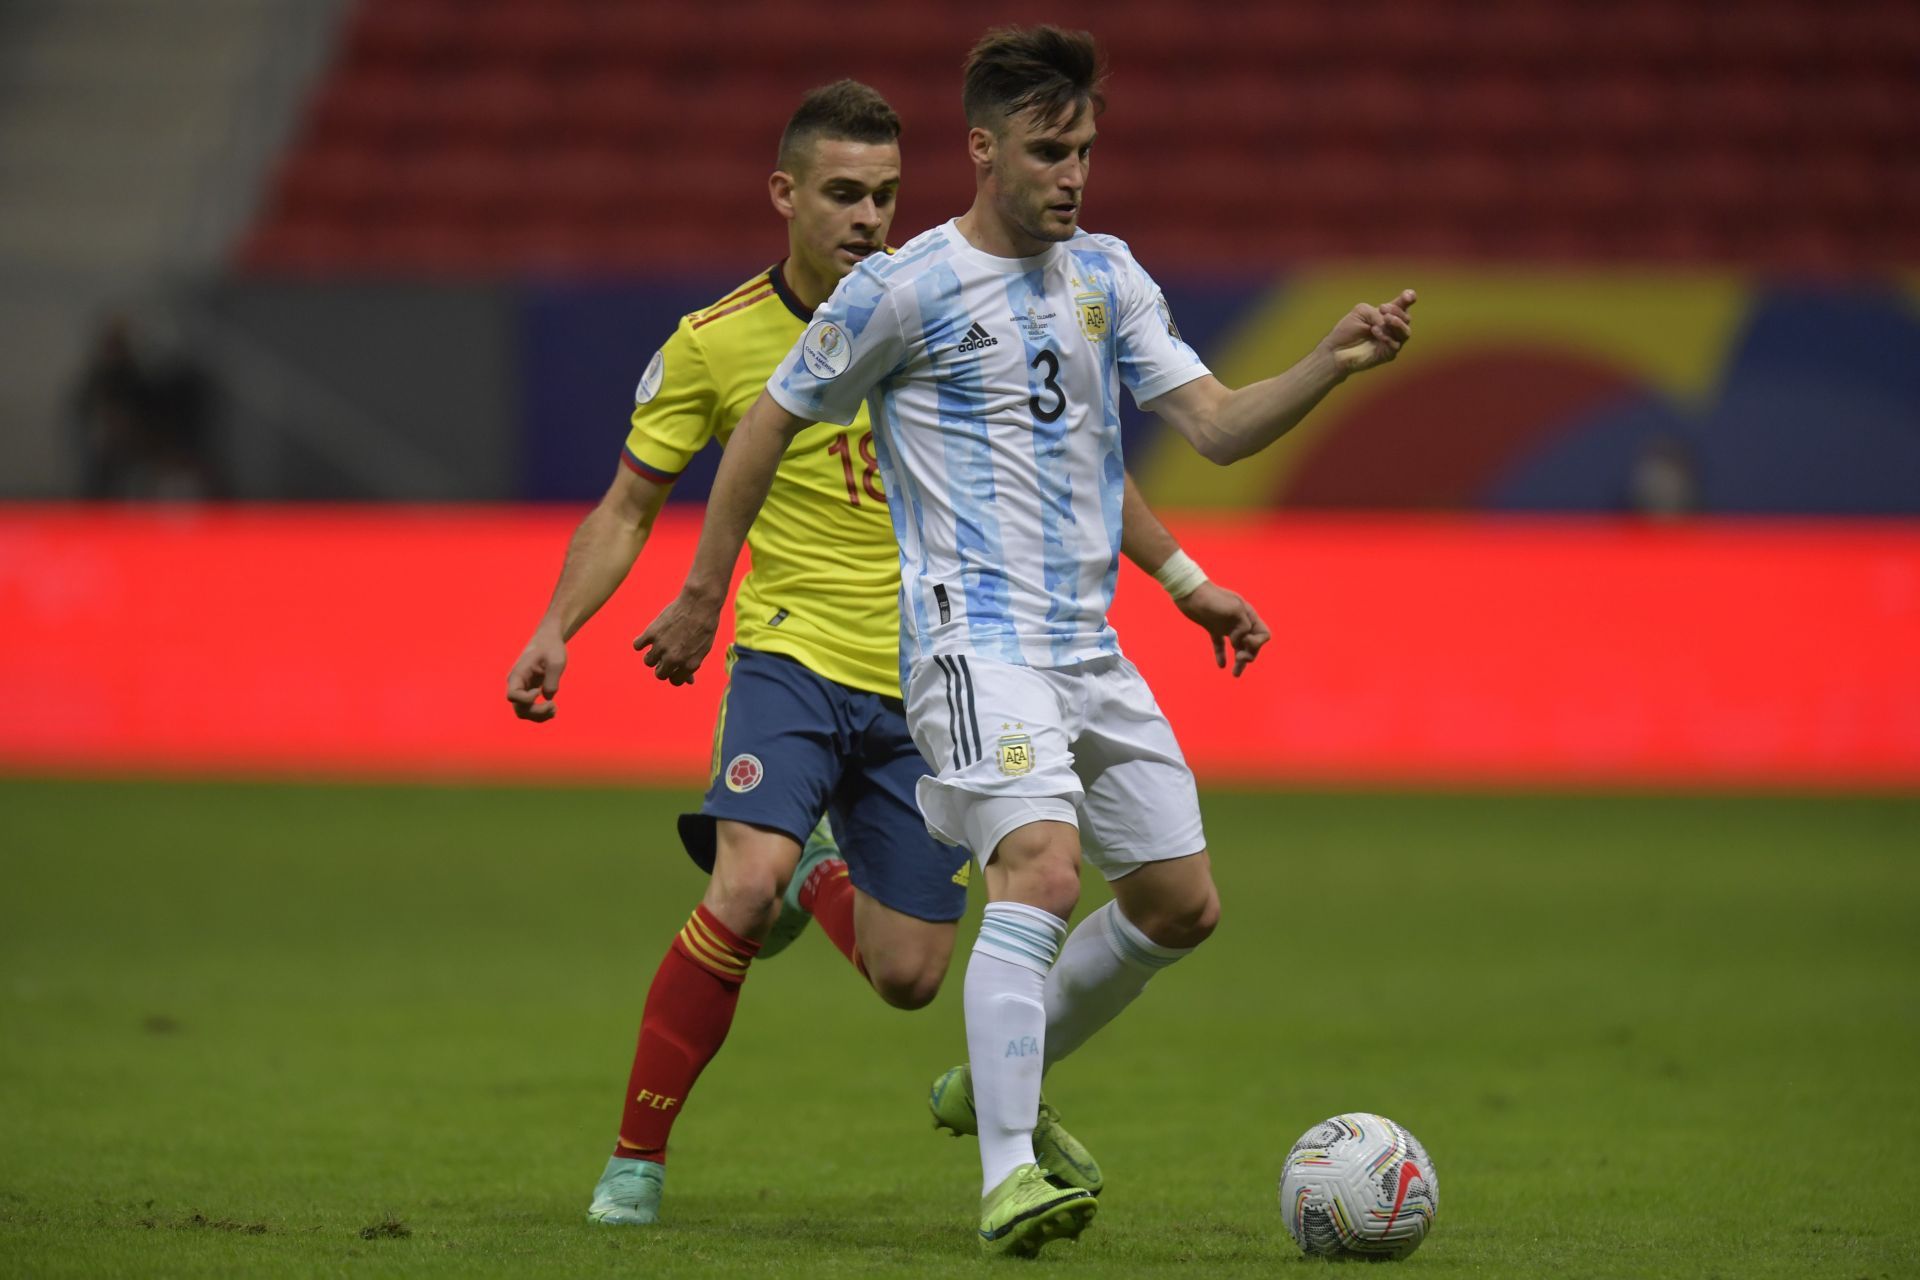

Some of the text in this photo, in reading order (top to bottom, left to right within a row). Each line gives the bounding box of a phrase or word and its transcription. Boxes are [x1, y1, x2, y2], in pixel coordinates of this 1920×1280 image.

[958, 337, 998, 352] adidas
[1029, 349, 1066, 424] 3
[1006, 746, 1027, 765] AFA
[1005, 1036, 1039, 1058] AFA
